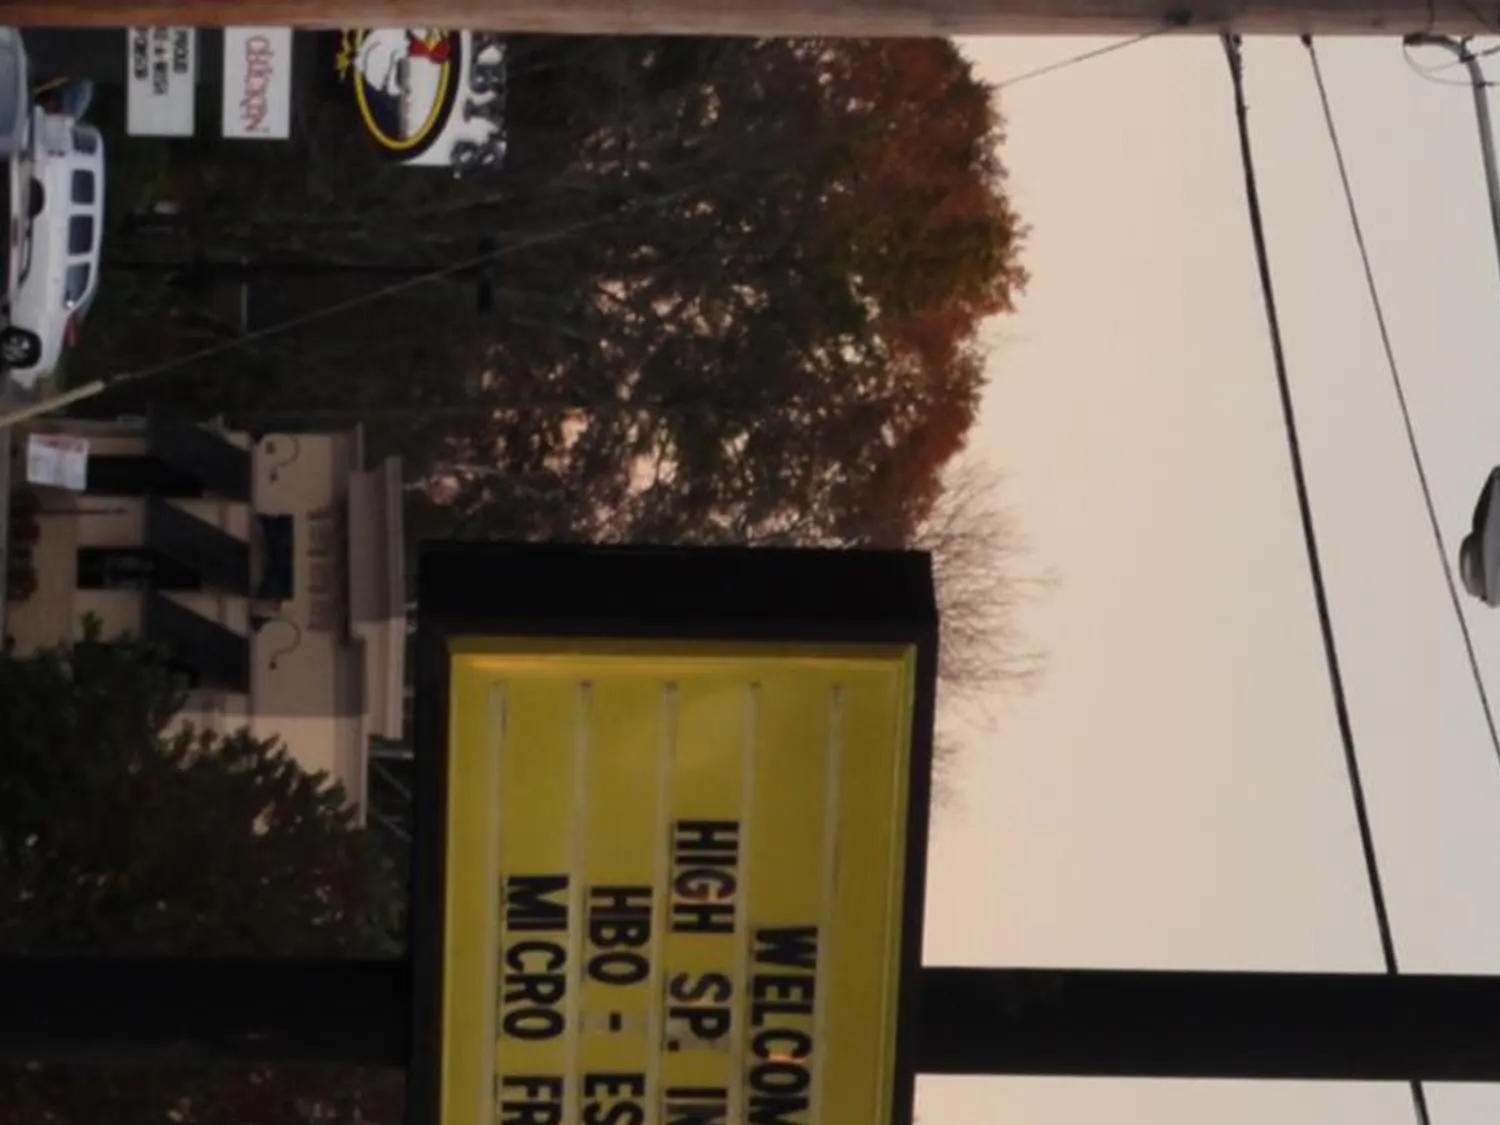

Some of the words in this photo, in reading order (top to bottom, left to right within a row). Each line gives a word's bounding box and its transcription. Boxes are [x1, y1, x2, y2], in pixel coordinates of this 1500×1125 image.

[672, 820, 740, 934] HIGH
[502, 874, 569, 1041] MICRO
[587, 885, 653, 985] HBO
[667, 972, 732, 1052] SP.
